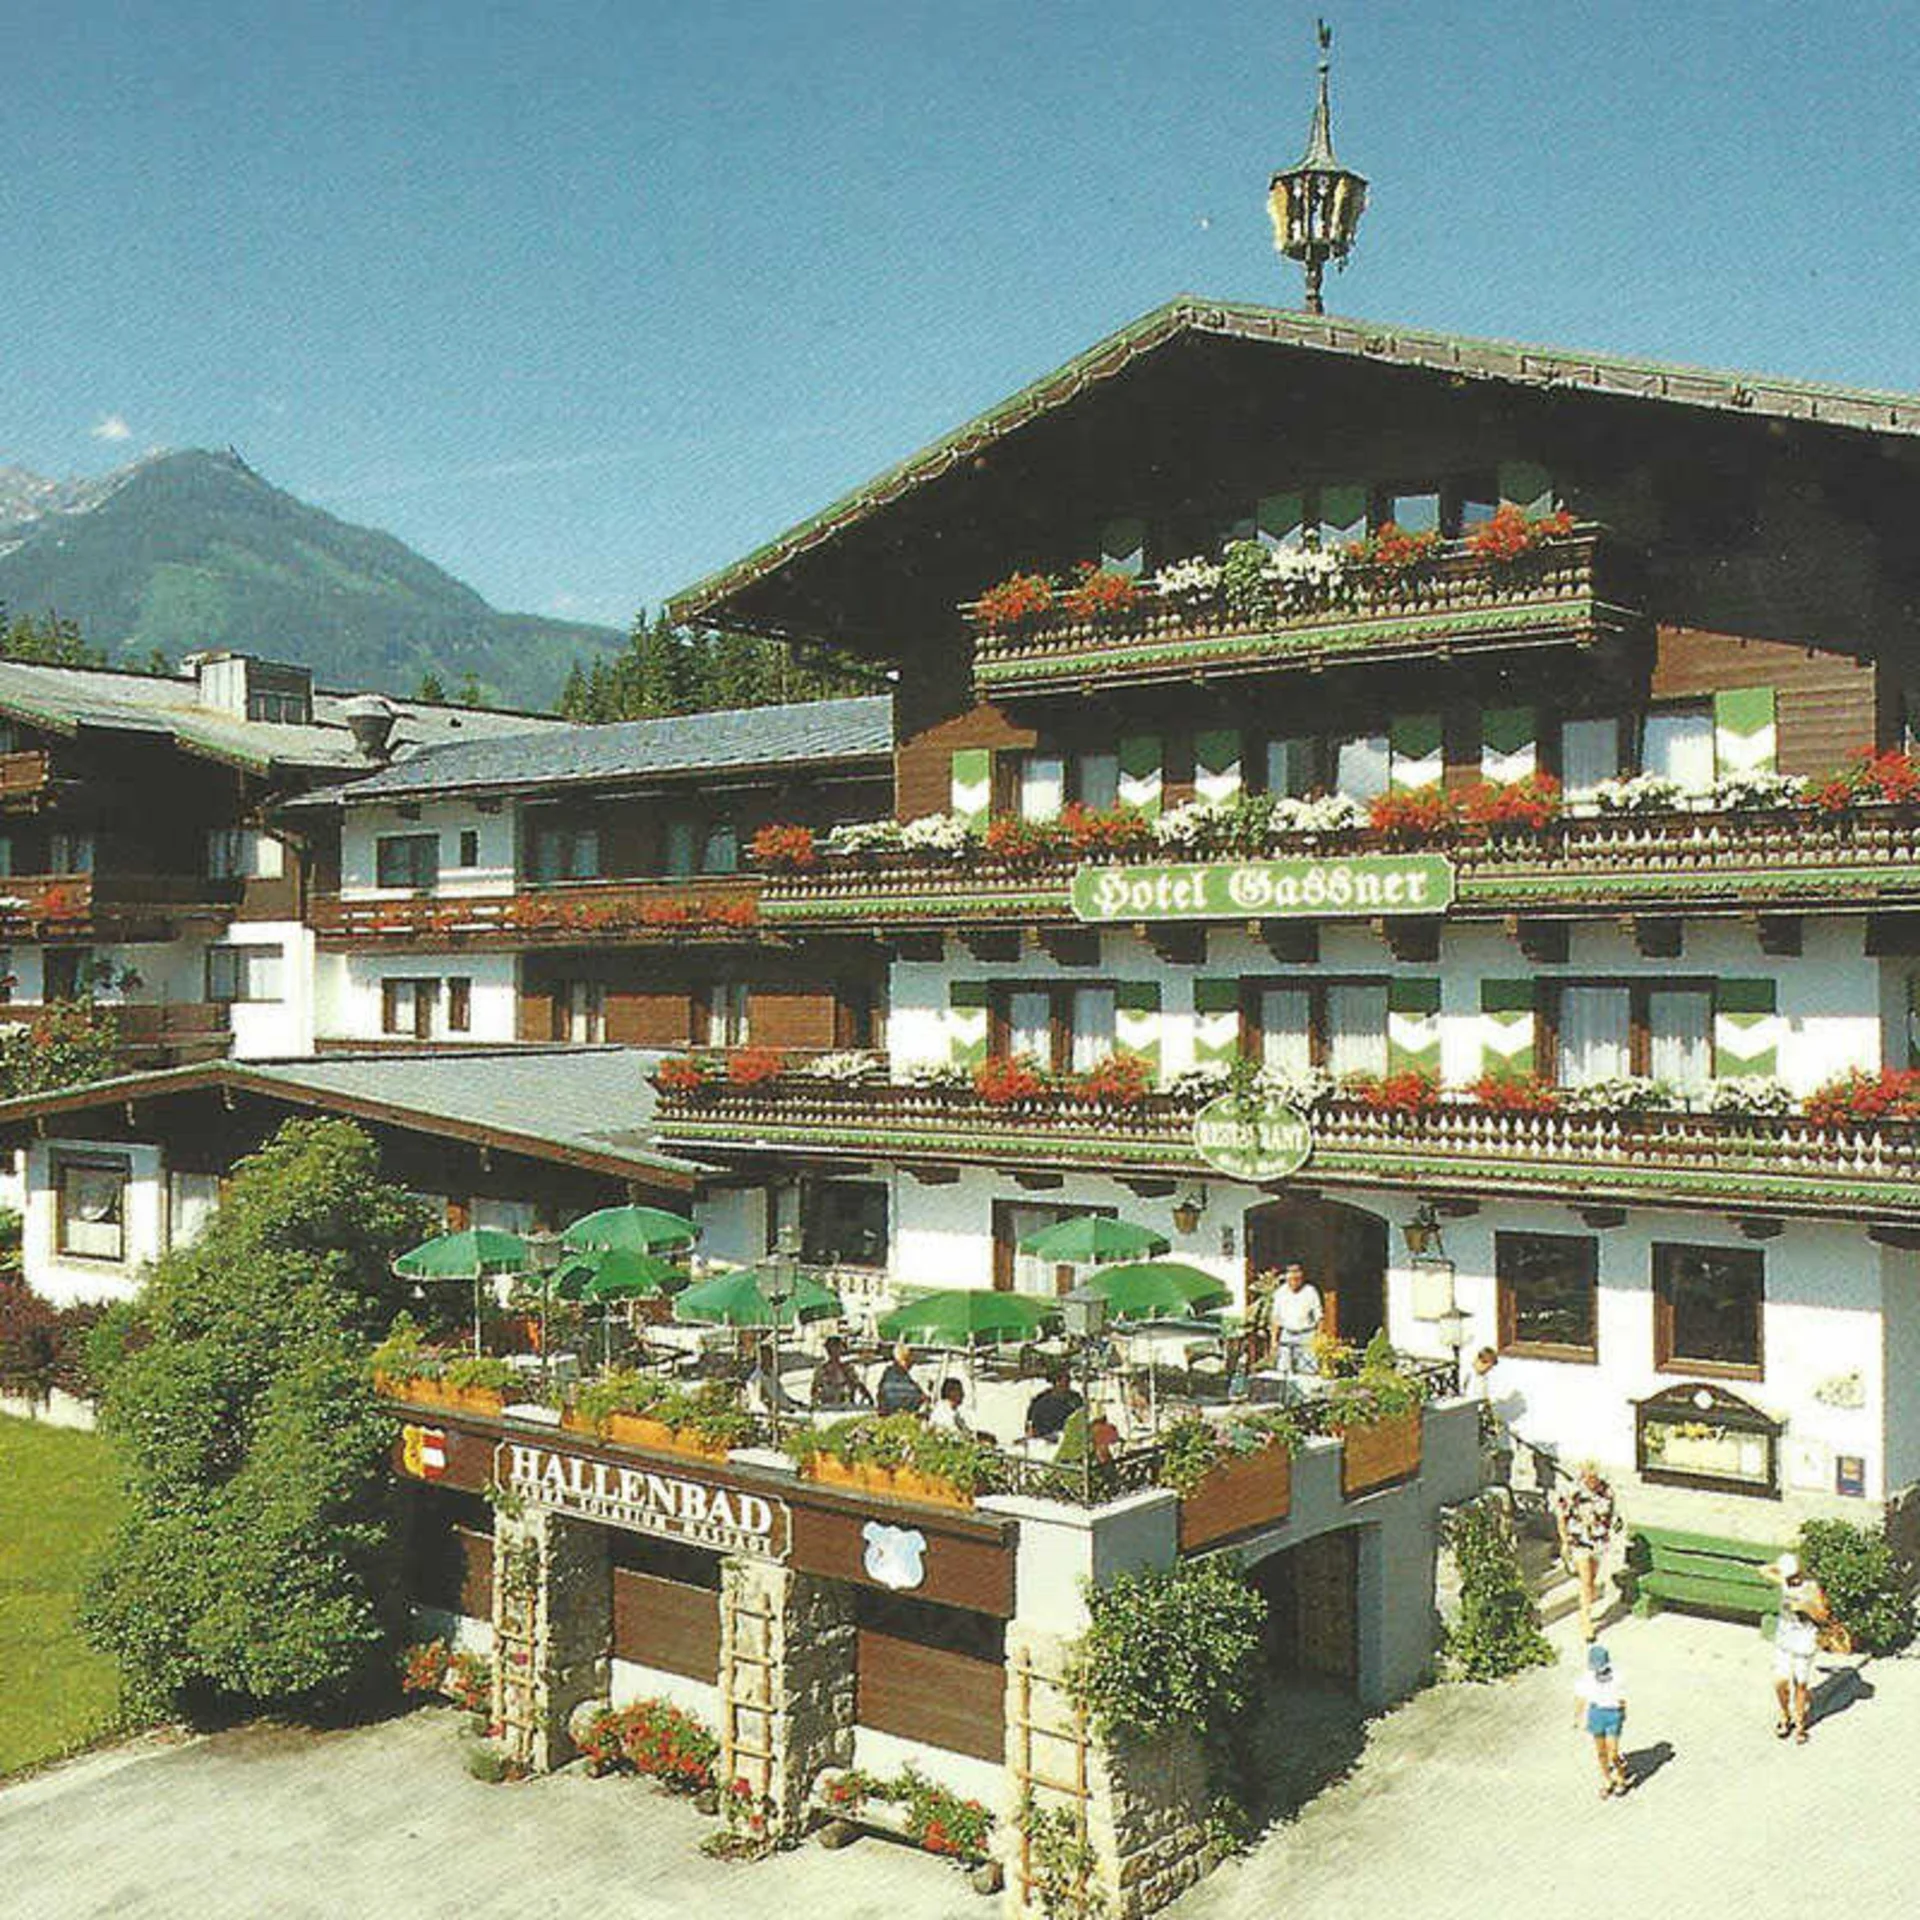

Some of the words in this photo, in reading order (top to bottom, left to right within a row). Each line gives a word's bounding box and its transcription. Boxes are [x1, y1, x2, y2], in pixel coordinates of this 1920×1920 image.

[1093, 868, 1208, 914] Hotel
[1228, 864, 1428, 909] Gassner
[510, 1445, 772, 1534] HALLENBAD
